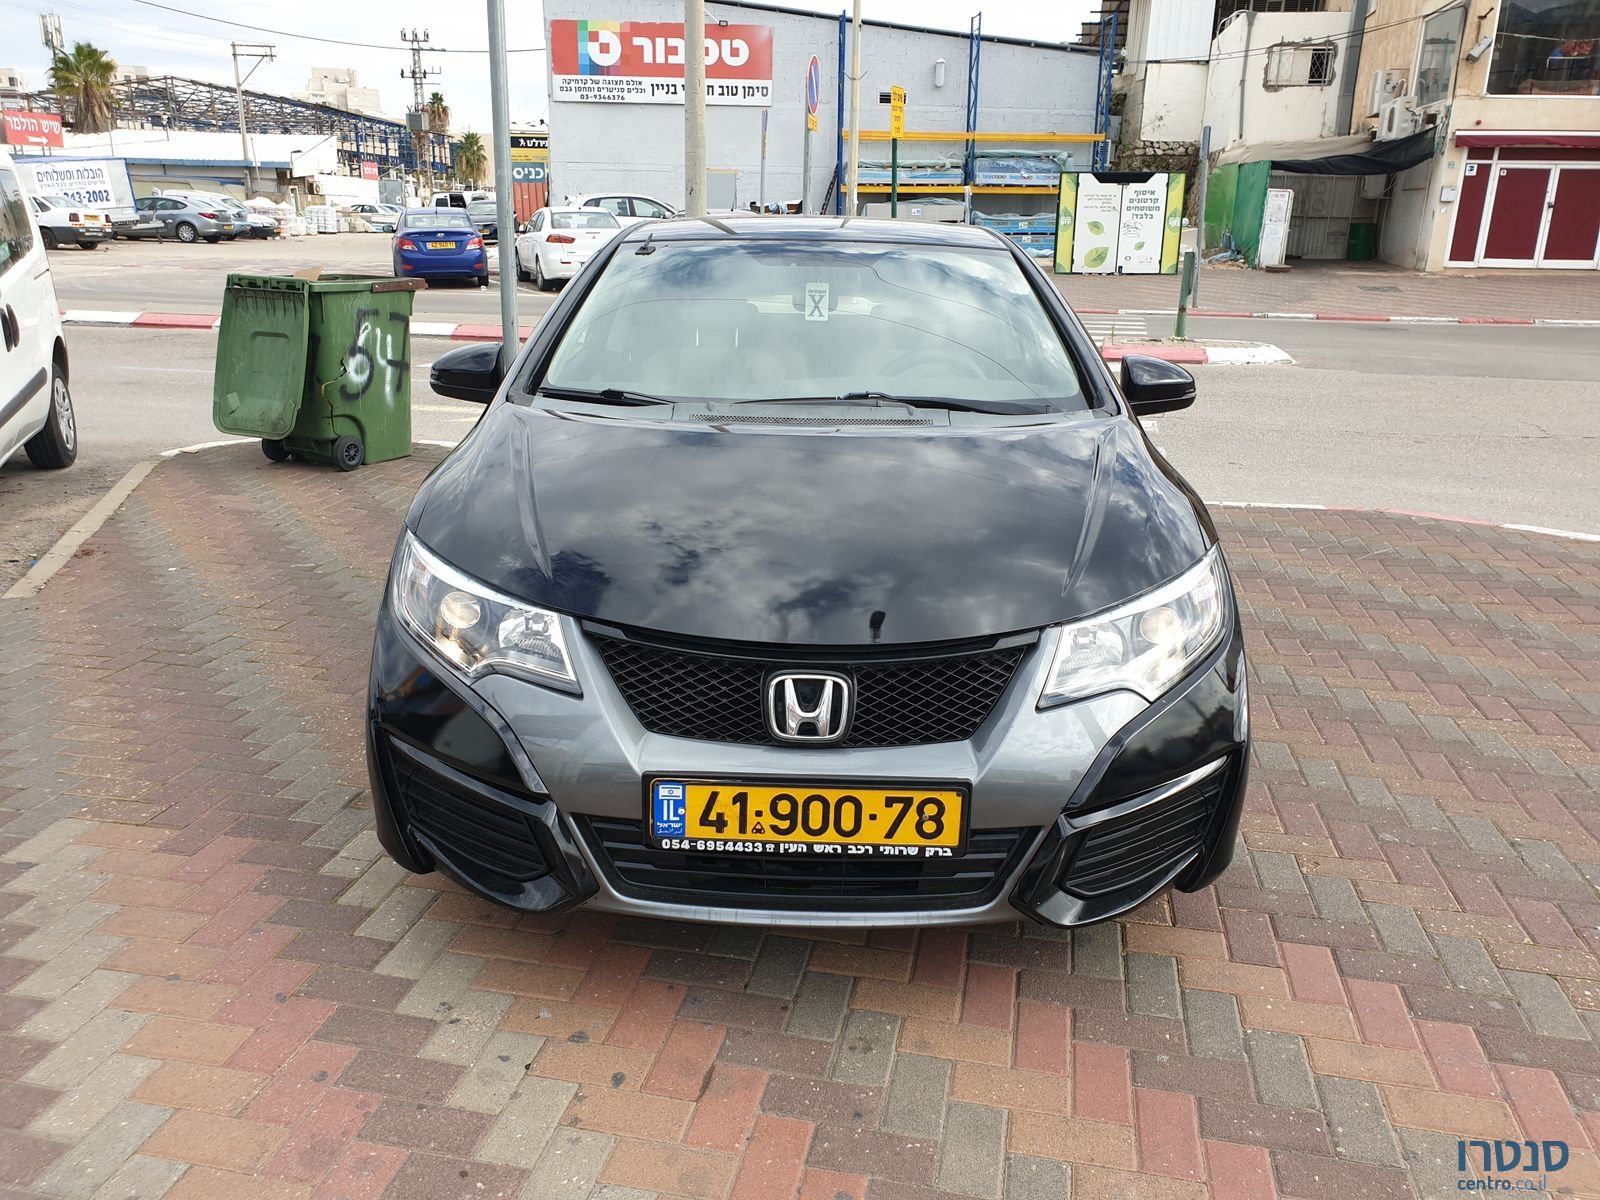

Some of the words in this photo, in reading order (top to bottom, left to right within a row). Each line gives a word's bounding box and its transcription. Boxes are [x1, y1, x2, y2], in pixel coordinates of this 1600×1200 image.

[562, 78, 588, 86] קרמיקה
[589, 77, 600, 85] של
[650, 83, 678, 97] בניין
[718, 85, 738, 97] טוב
[742, 86, 769, 99] סימן
[41, 120, 61, 134] שיש
[36, 169, 75, 182] ומשלוחים
[76, 167, 104, 181] הובלות
[1128, 197, 1159, 205] קרטונים
[1131, 212, 1154, 220] בלבד!
[807, 294, 827, 318] X
[663, 799, 680, 821] IL
[661, 838, 763, 852] 054-6954433
[779, 843, 807, 854] העין
[813, 843, 842, 853] ראש
[847, 844, 873, 854] רכב
[879, 845, 919, 855] שרותי
[925, 847, 953, 857] ברק
